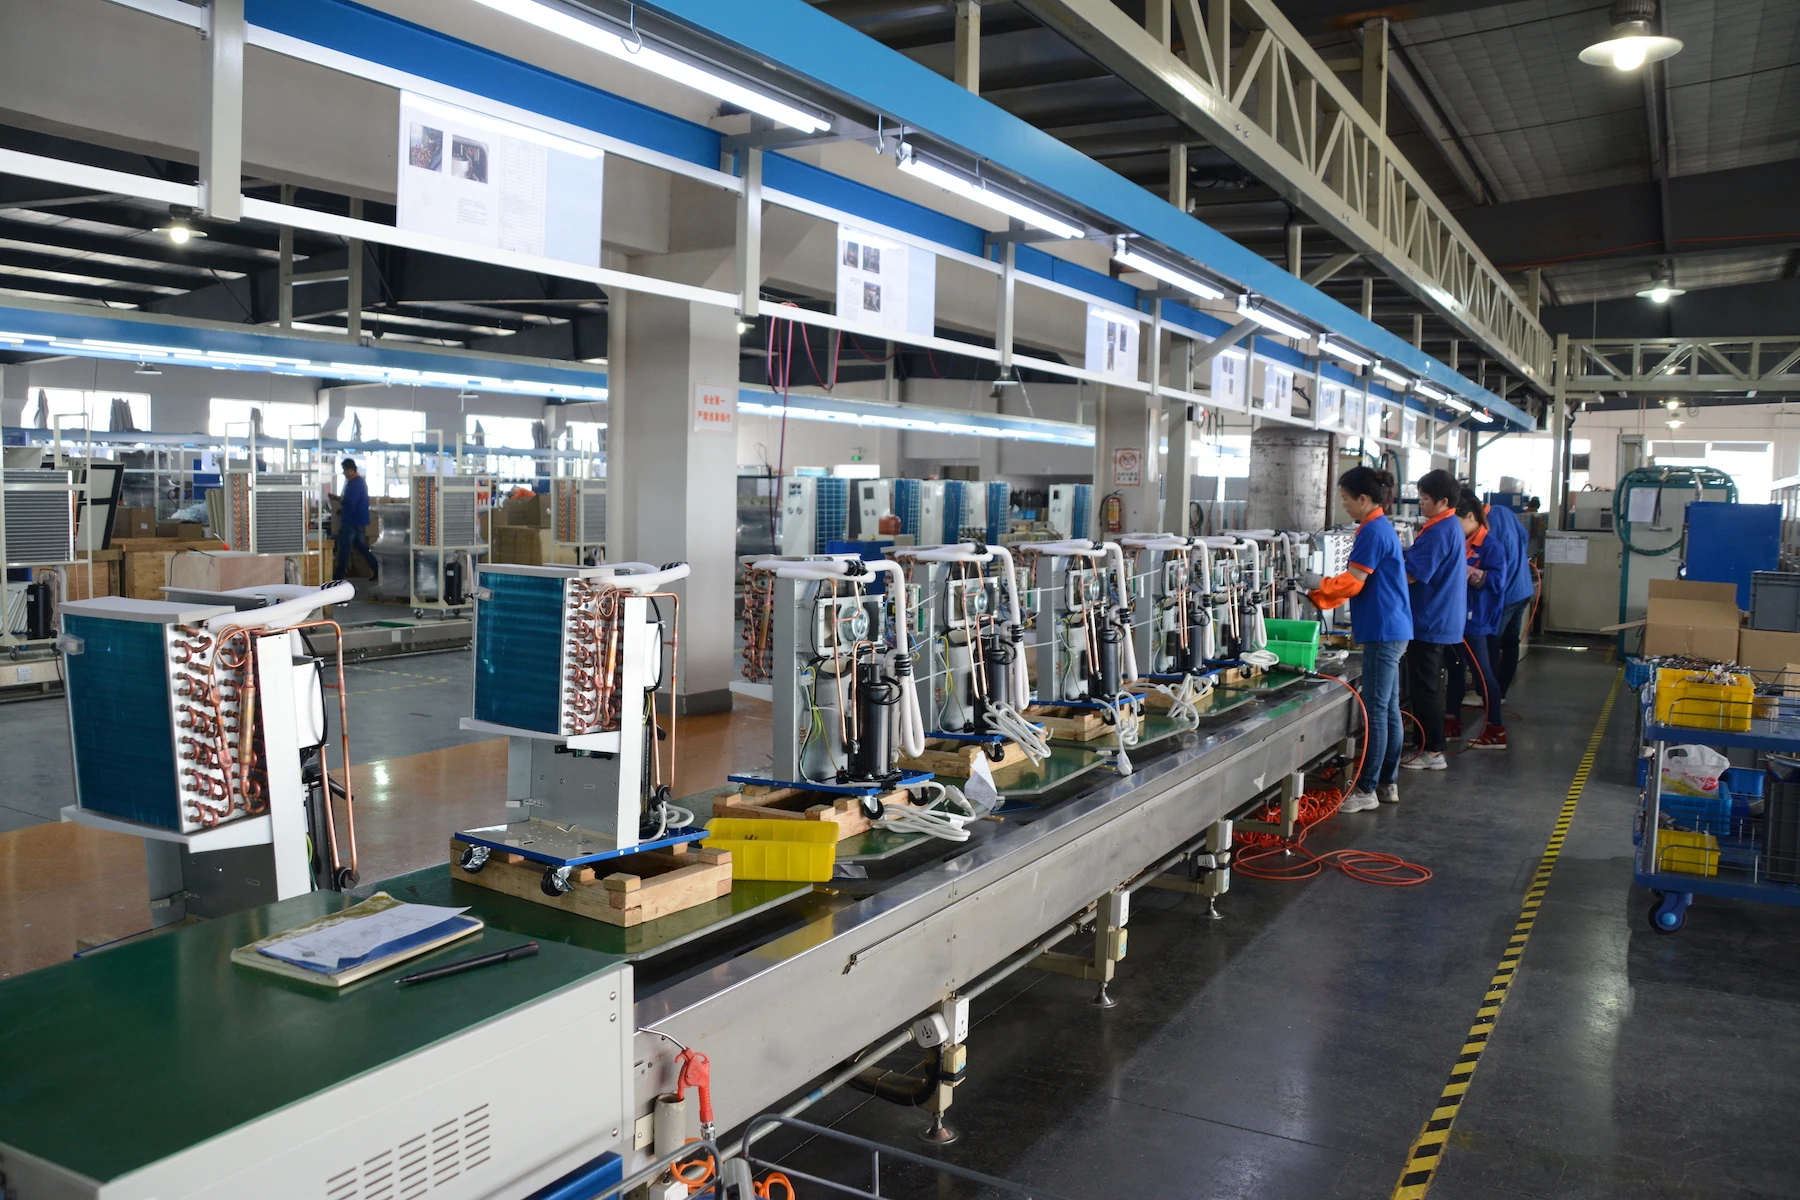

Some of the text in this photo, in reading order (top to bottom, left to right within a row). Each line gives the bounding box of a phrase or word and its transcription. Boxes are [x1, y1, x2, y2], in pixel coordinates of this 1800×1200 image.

[704, 394, 726, 405] 安全第一
[697, 410, 731, 422] 严禁违章操作
